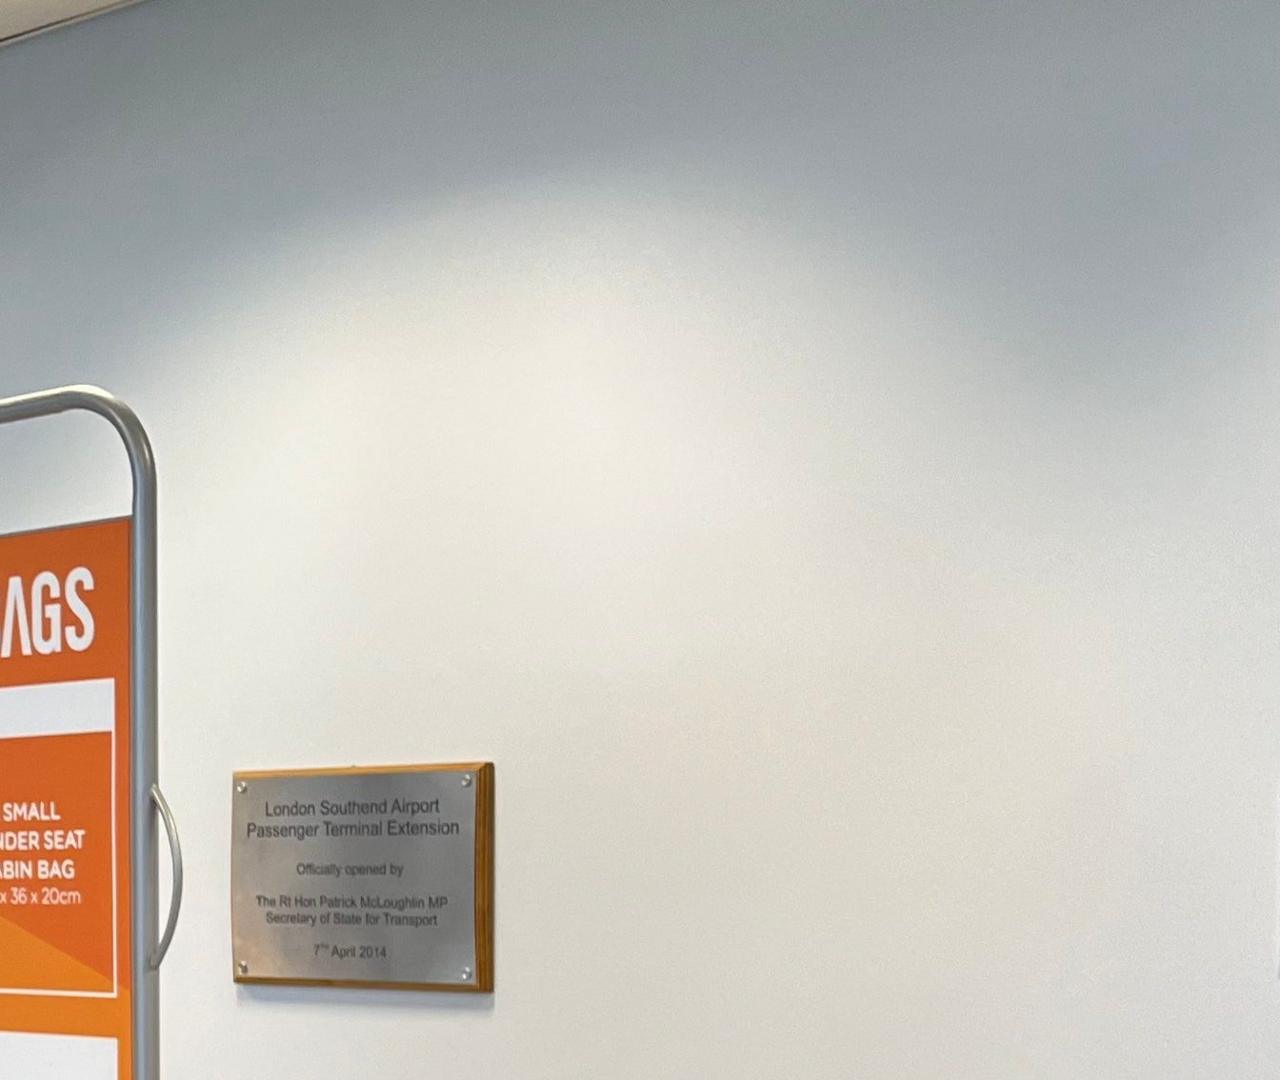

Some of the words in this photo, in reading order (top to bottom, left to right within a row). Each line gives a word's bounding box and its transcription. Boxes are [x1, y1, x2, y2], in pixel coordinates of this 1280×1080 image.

[2, 802, 61, 822] SMALL
[265, 801, 315, 817] London
[320, 799, 387, 816] Southend
[391, 798, 440, 817] Airport
[246, 821, 319, 841] Passenger
[323, 820, 382, 837] Terminal
[388, 819, 459, 836] Extension
[43, 830, 86, 850] SEAT
[37, 859, 75, 880] BAG
[296, 863, 342, 878] Officially
[345, 863, 387, 878] opened
[389, 863, 404, 878] by
[0, 891, 7, 904] x
[10, 887, 27, 905] 36
[31, 891, 38, 904] x
[41, 887, 82, 905] 20cm
[256, 895, 276, 908] The
[279, 895, 292, 908] Rt
[294, 895, 317, 909] Hon
[319, 895, 357, 909] Patrick
[360, 895, 425, 912] McLoughlin
[428, 895, 448, 909] MP
[266, 911, 316, 928] Secretary
[320, 911, 331, 925] of
[333, 912, 362, 925] State
[365, 911, 380, 925] for
[383, 912, 438, 928] Transport
[331, 944, 357, 960] April
[359, 944, 387, 959] 2014
